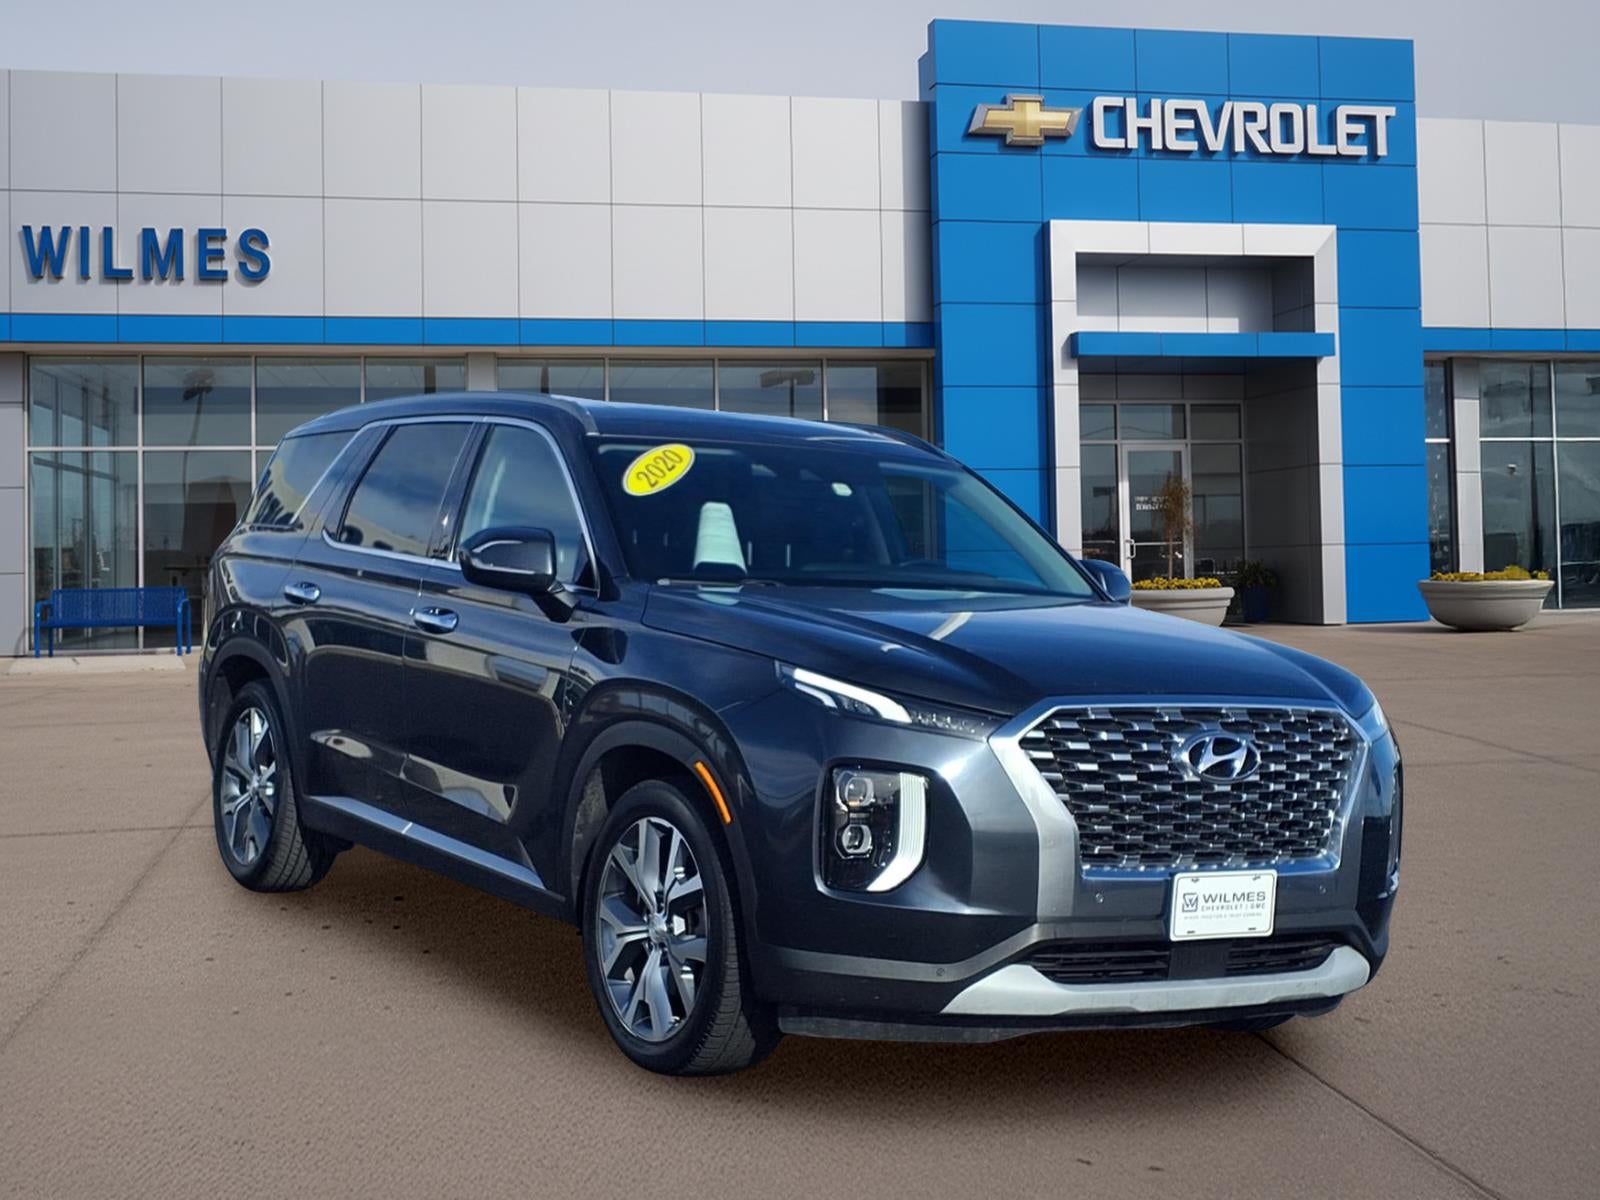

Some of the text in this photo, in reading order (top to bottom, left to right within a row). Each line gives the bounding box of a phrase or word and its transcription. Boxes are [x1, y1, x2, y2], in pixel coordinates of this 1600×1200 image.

[1092, 96, 1397, 157] CHEVROLET
[21, 225, 271, 281] WILMES
[636, 449, 684, 488] 2020
[1203, 891, 1266, 903] WILMES
